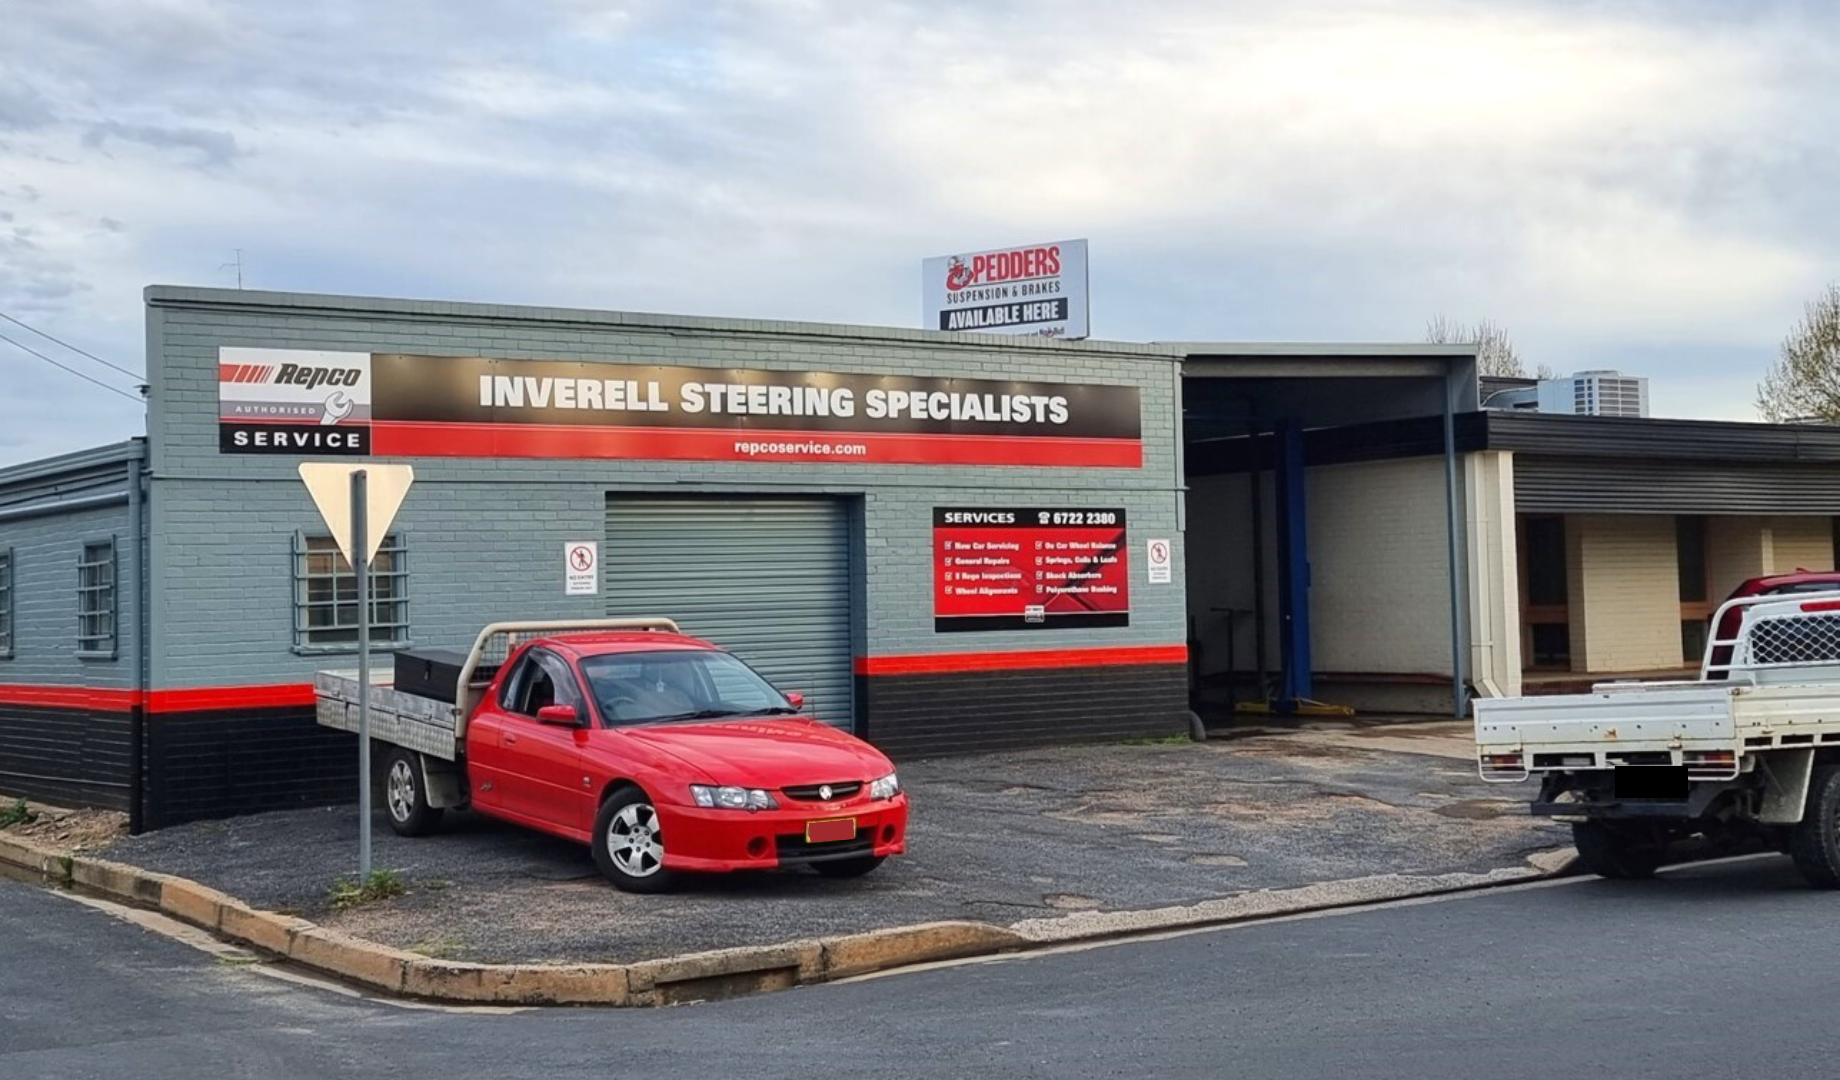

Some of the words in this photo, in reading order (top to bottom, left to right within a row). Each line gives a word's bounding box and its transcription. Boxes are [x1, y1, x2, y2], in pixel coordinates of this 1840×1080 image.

[973, 246, 1060, 283] PEDDERS
[947, 287, 1008, 304] SUSPENSION
[1012, 286, 1018, 297] &
[1022, 281, 1060, 296] BRAKES
[948, 307, 1020, 330] AVAILABLE
[1023, 301, 1059, 322] HERE
[274, 363, 362, 389] Repco
[479, 375, 669, 411] INVERELL
[680, 382, 854, 418] STEERING
[865, 388, 1069, 424] SPECIALISTS
[235, 405, 316, 415] AUTHORISED
[234, 431, 360, 448] SERVICE
[734, 440, 866, 455] repcoservice.com
[945, 512, 1015, 523] SERVICES
[1053, 512, 1083, 524] 6722
[1086, 512, 1116, 524] 2380
[972, 541, 985, 550] Car
[986, 541, 1019, 551] Servicing
[1069, 541, 1090, 550] Wheel
[955, 557, 982, 565] General
[983, 557, 1010, 566] Repairs
[981, 571, 1022, 581] Inspections
[1045, 571, 1067, 579] Shock
[1068, 571, 1102, 579] Absorbers
[955, 586, 977, 595] Wheel
[978, 586, 1018, 596] Alignments
